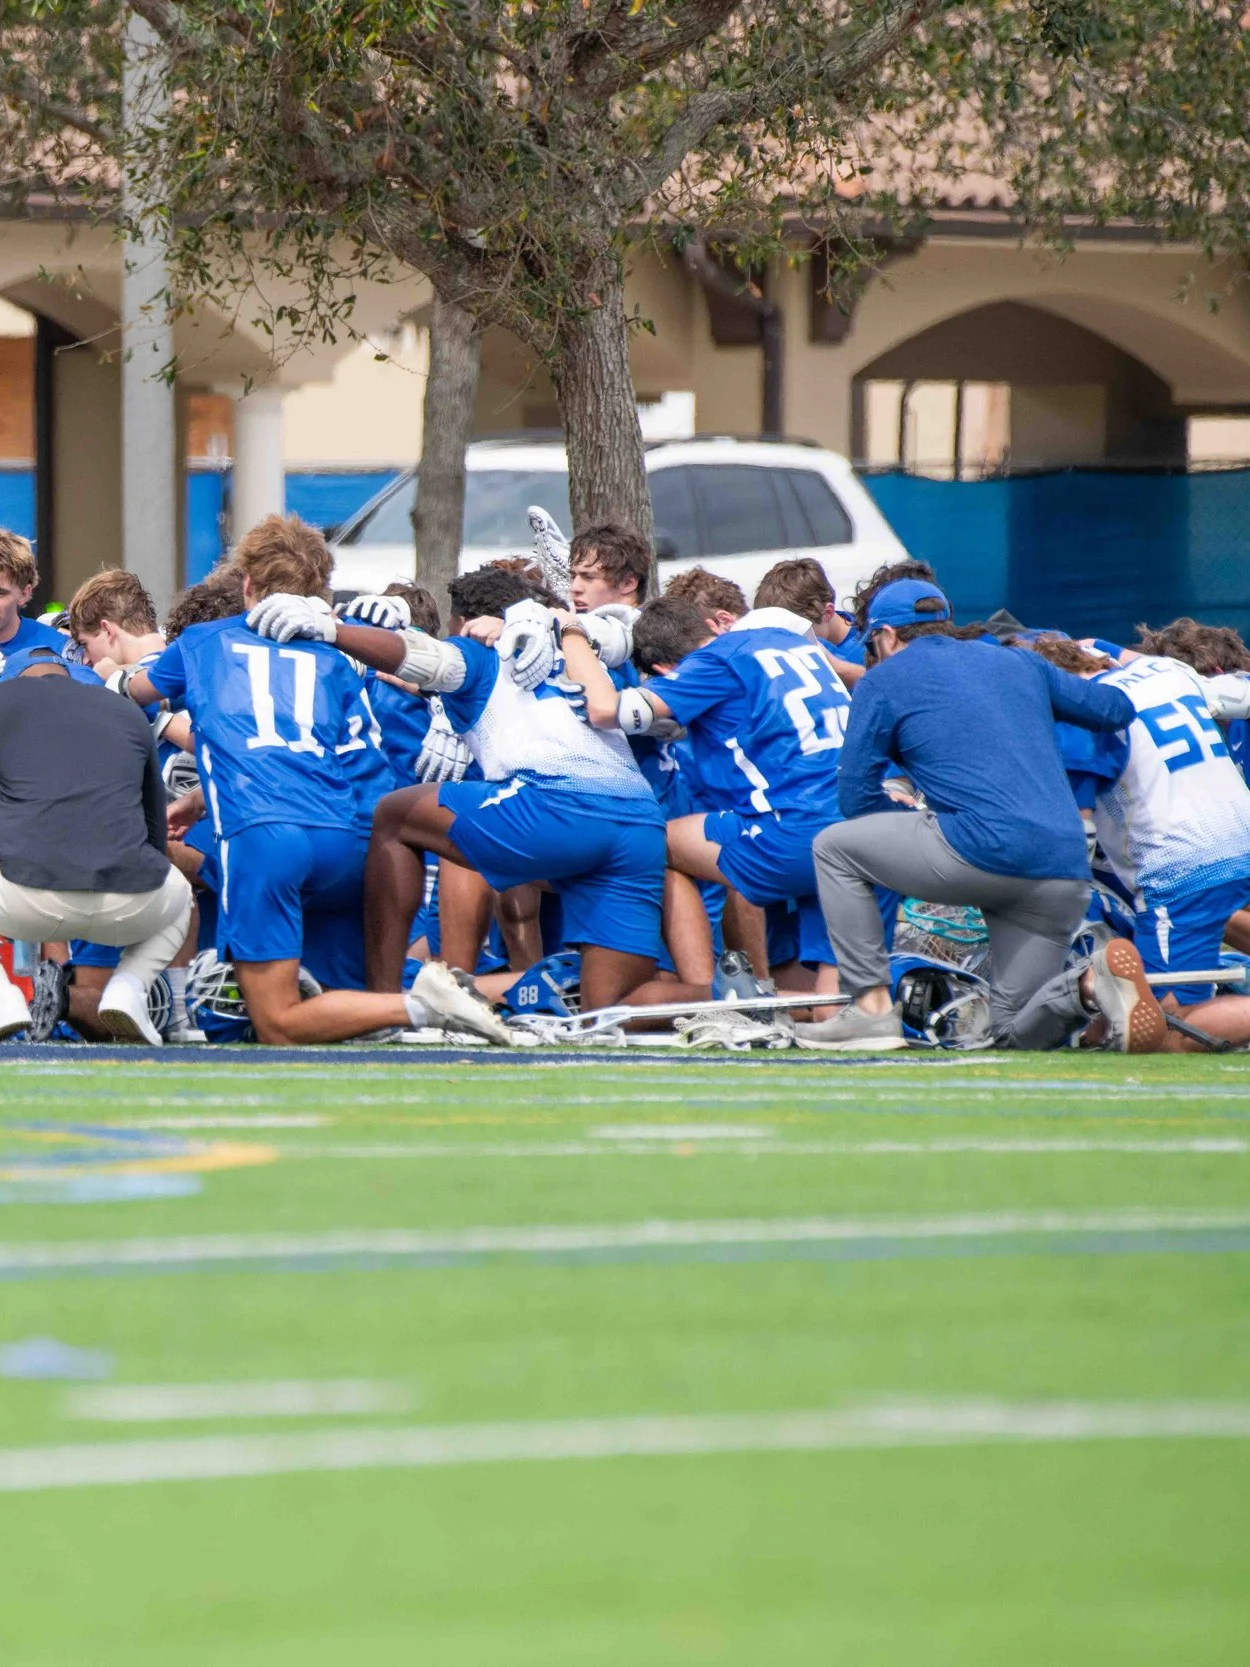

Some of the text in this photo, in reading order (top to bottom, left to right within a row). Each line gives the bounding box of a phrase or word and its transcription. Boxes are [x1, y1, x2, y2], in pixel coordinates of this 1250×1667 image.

[231, 643, 325, 758] 11
[753, 644, 853, 757] 23
[1137, 694, 1231, 774] 55
[517, 985, 539, 1007] 88
